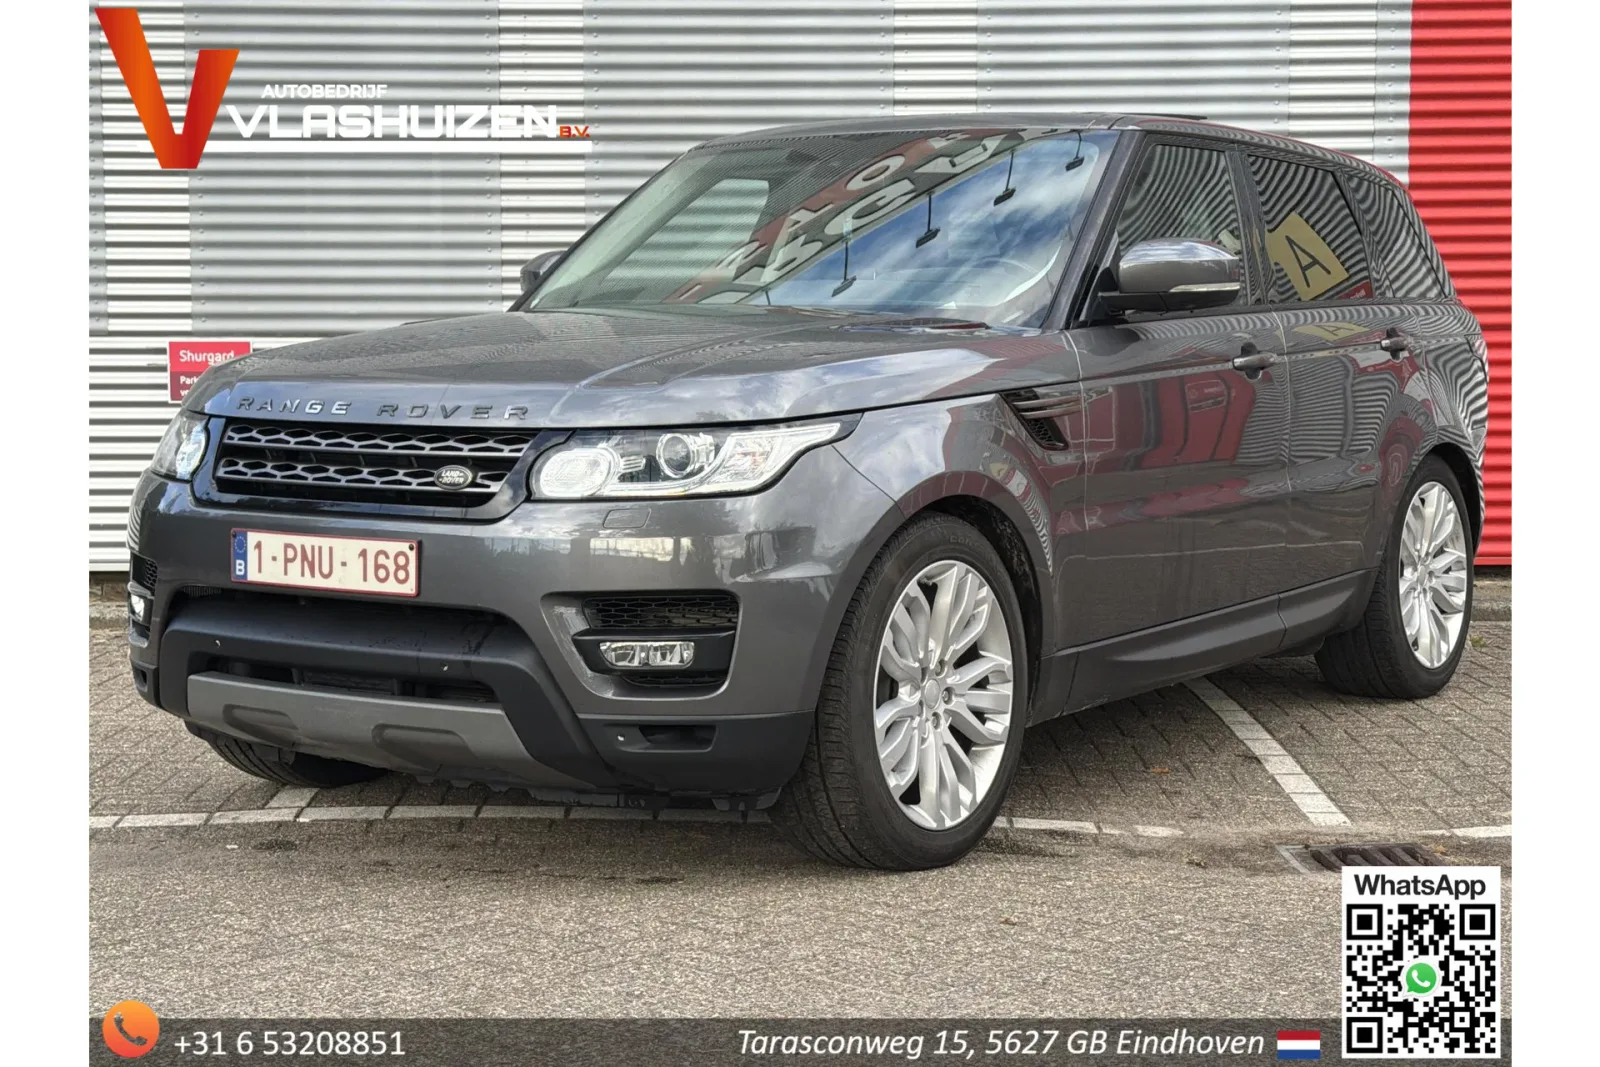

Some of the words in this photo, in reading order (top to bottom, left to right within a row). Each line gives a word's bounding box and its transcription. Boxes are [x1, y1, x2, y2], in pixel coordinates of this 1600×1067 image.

[179, 349, 234, 365] Shurgard
[236, 396, 351, 415] RANGE
[376, 402, 529, 421] ROVER
[235, 560, 245, 575] B
